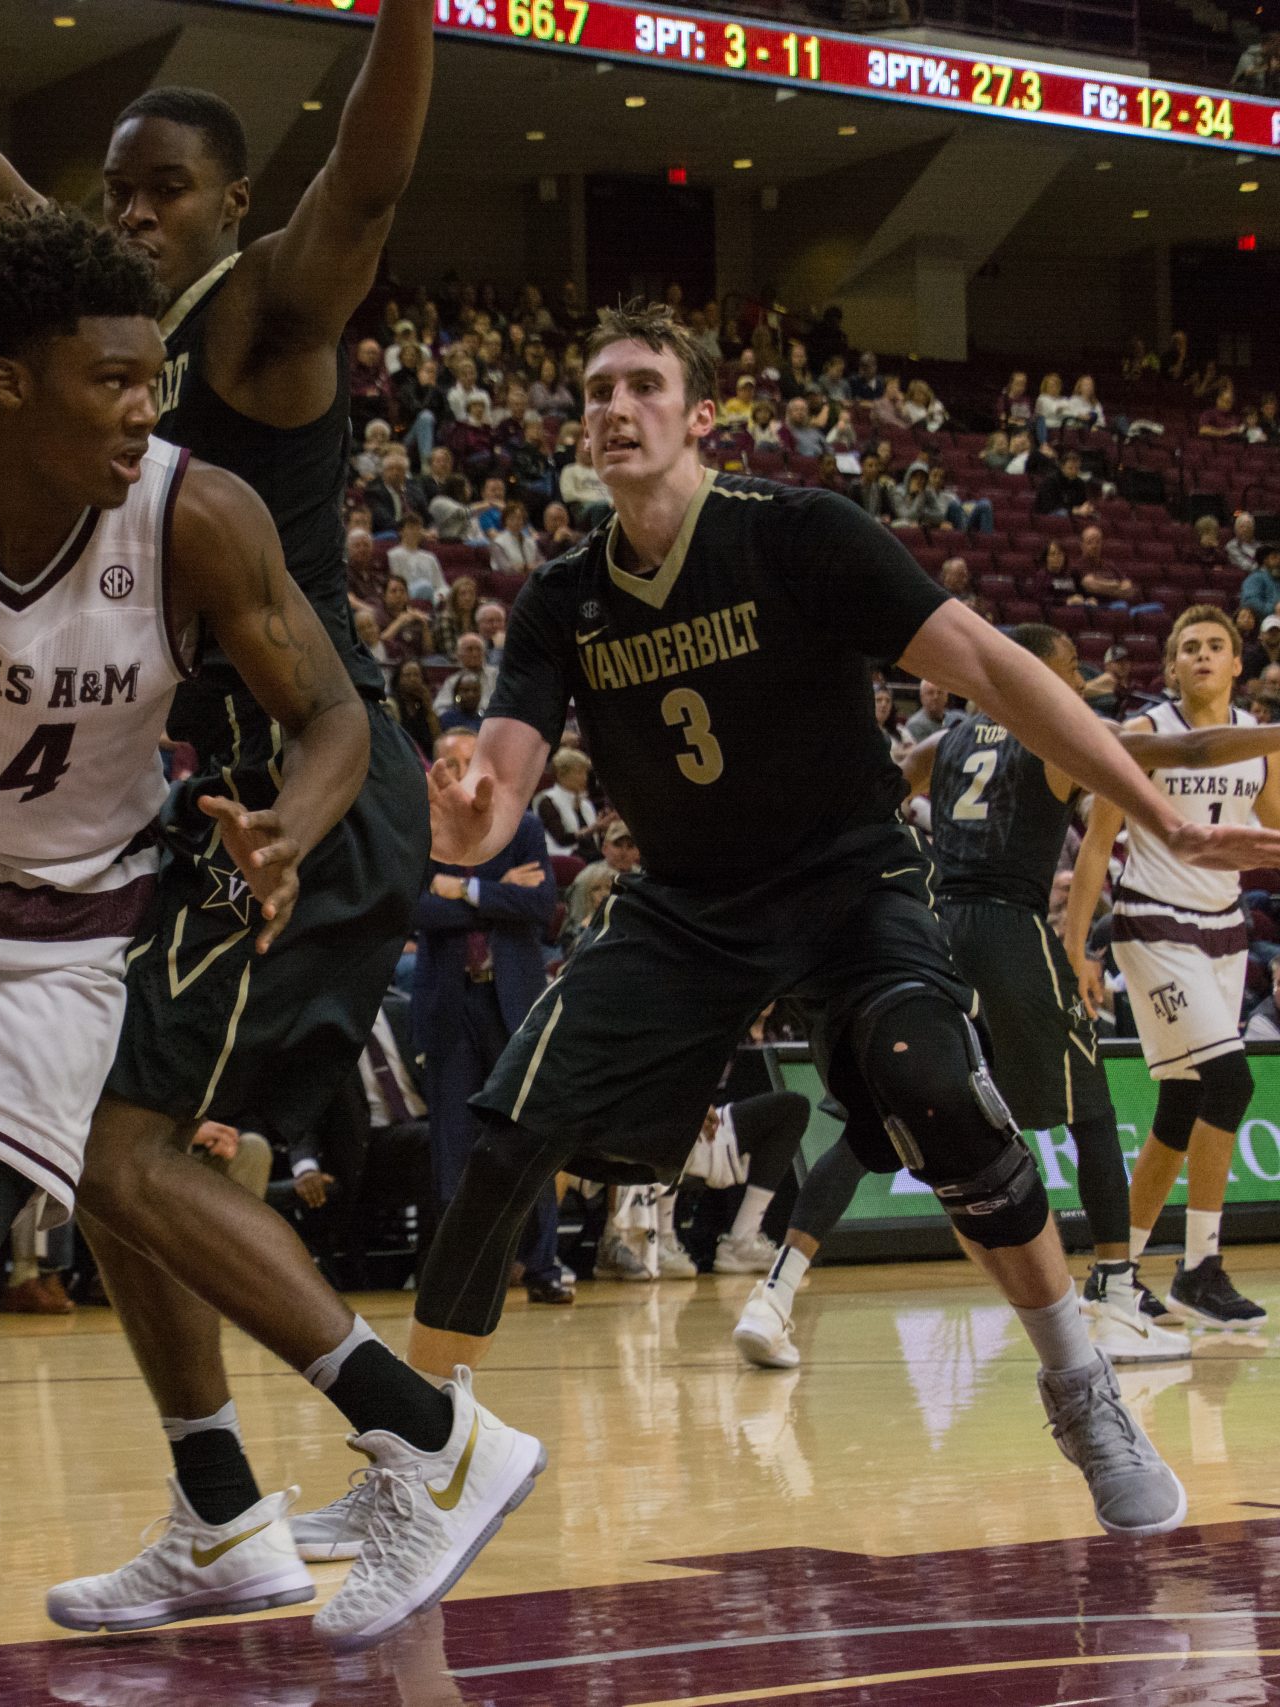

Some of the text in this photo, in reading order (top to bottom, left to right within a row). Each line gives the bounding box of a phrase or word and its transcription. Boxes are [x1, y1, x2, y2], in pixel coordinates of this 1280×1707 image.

[508, 0, 589, 45] 66.7
[635, 15, 705, 60] 3PT:
[724, 23, 746, 69] 3
[757, 48, 769, 61] -
[783, 33, 820, 80] 11
[869, 50, 960, 96] 3PT%:
[972, 62, 1042, 112] 27.3
[1082, 83, 1128, 121] FG:
[1136, 87, 1172, 131] 12
[1195, 95, 1234, 140] 34
[102, 566, 133, 597] SEC
[581, 601, 599, 619] SEC
[578, 600, 760, 690] VANDERBILT
[47, 662, 141, 708] A&M
[661, 687, 724, 785] 3
[952, 749, 998, 820] 2
[1165, 777, 1259, 799] TEXAS A&M
[1208, 802, 1223, 825] 1
